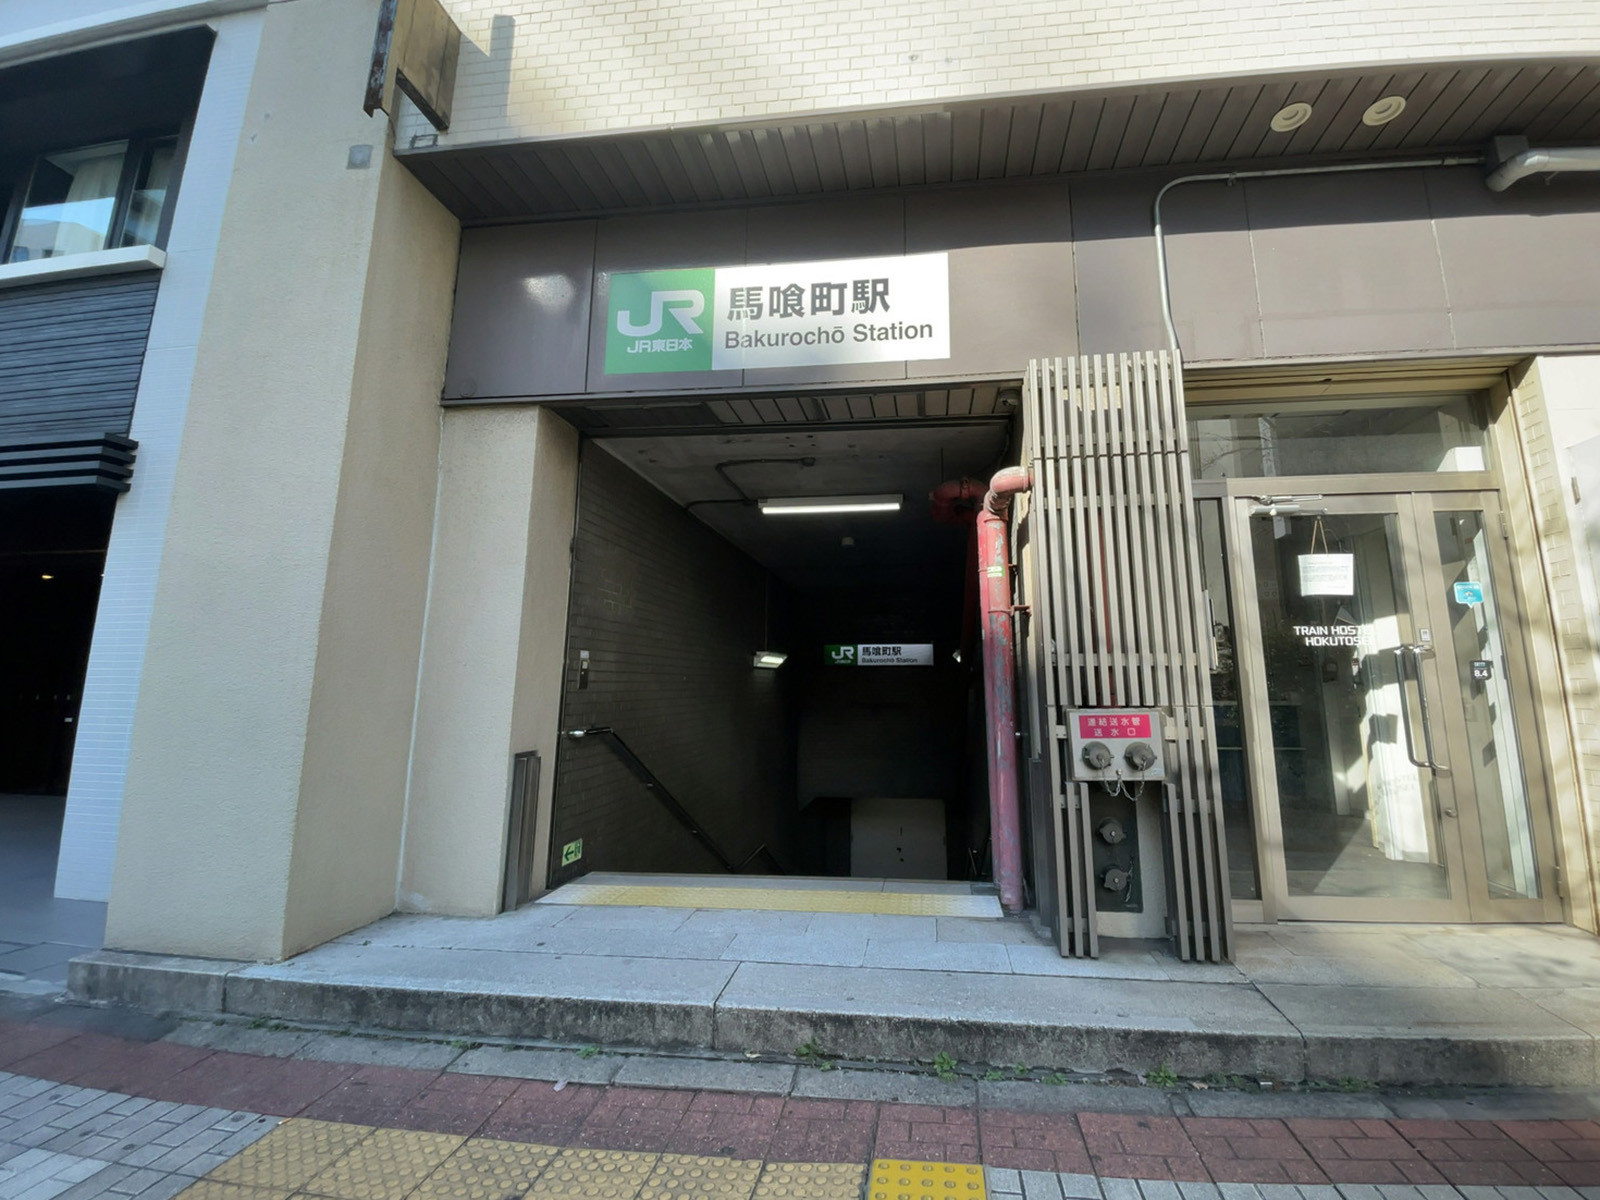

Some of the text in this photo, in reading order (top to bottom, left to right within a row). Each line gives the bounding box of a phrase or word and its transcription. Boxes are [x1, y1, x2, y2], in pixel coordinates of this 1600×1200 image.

[727, 278, 890, 321] 馬喰町駅
[617, 289, 705, 337] JR
[626, 337, 693, 354] JR東日本
[725, 322, 933, 349] Bakurochō Station
[1293, 626, 1328, 635] TRAIN
[832, 646, 854, 659] JR
